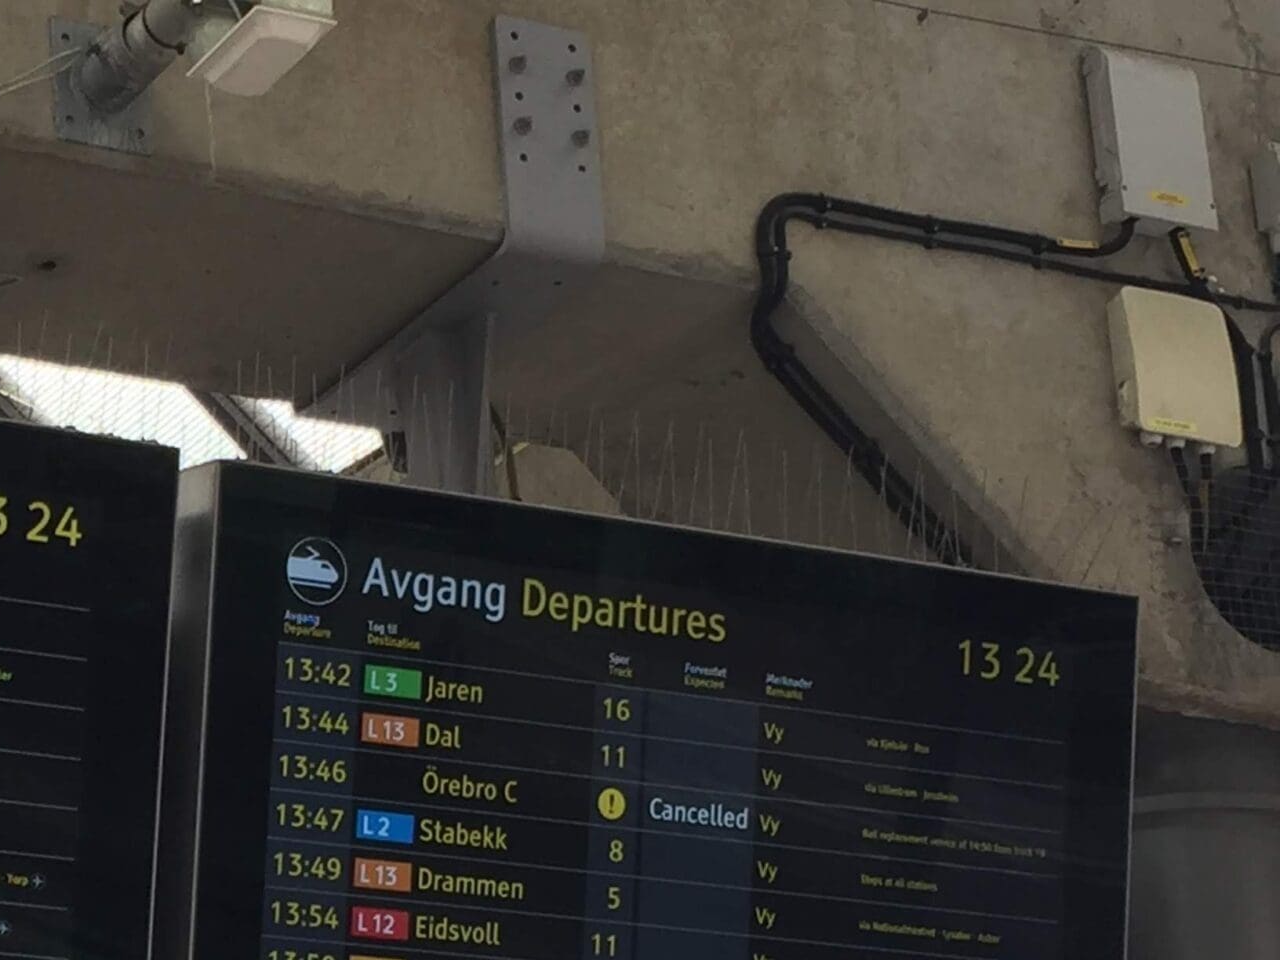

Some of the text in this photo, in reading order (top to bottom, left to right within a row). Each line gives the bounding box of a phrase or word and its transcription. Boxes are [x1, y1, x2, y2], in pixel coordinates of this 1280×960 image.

[27, 502, 82, 546] 24
[363, 558, 725, 641] Avgang Departures
[286, 657, 350, 686] 13:42
[426, 676, 482, 703] Jaren
[604, 698, 630, 721] 16
[764, 723, 784, 744] Vy
[959, 640, 1059, 686] 13 24
[283, 706, 349, 734] 13:44
[426, 723, 460, 748] Dal
[602, 745, 624, 768] 11
[762, 769, 781, 789] Vy
[280, 755, 780, 836] 13:46 Örebro C Cancelled Vy
[277, 804, 344, 831] 13:47
[420, 819, 507, 849] Stabekk
[610, 840, 623, 862] 8
[758, 861, 777, 882] Vy
[272, 901, 338, 929] 13:54
[416, 916, 499, 945] Eidsvoll
[593, 934, 615, 956] 11
[274, 853, 341, 880] 13:49
[419, 868, 523, 899] Drammen
[608, 887, 620, 909] 5
[756, 907, 775, 928] Vy
